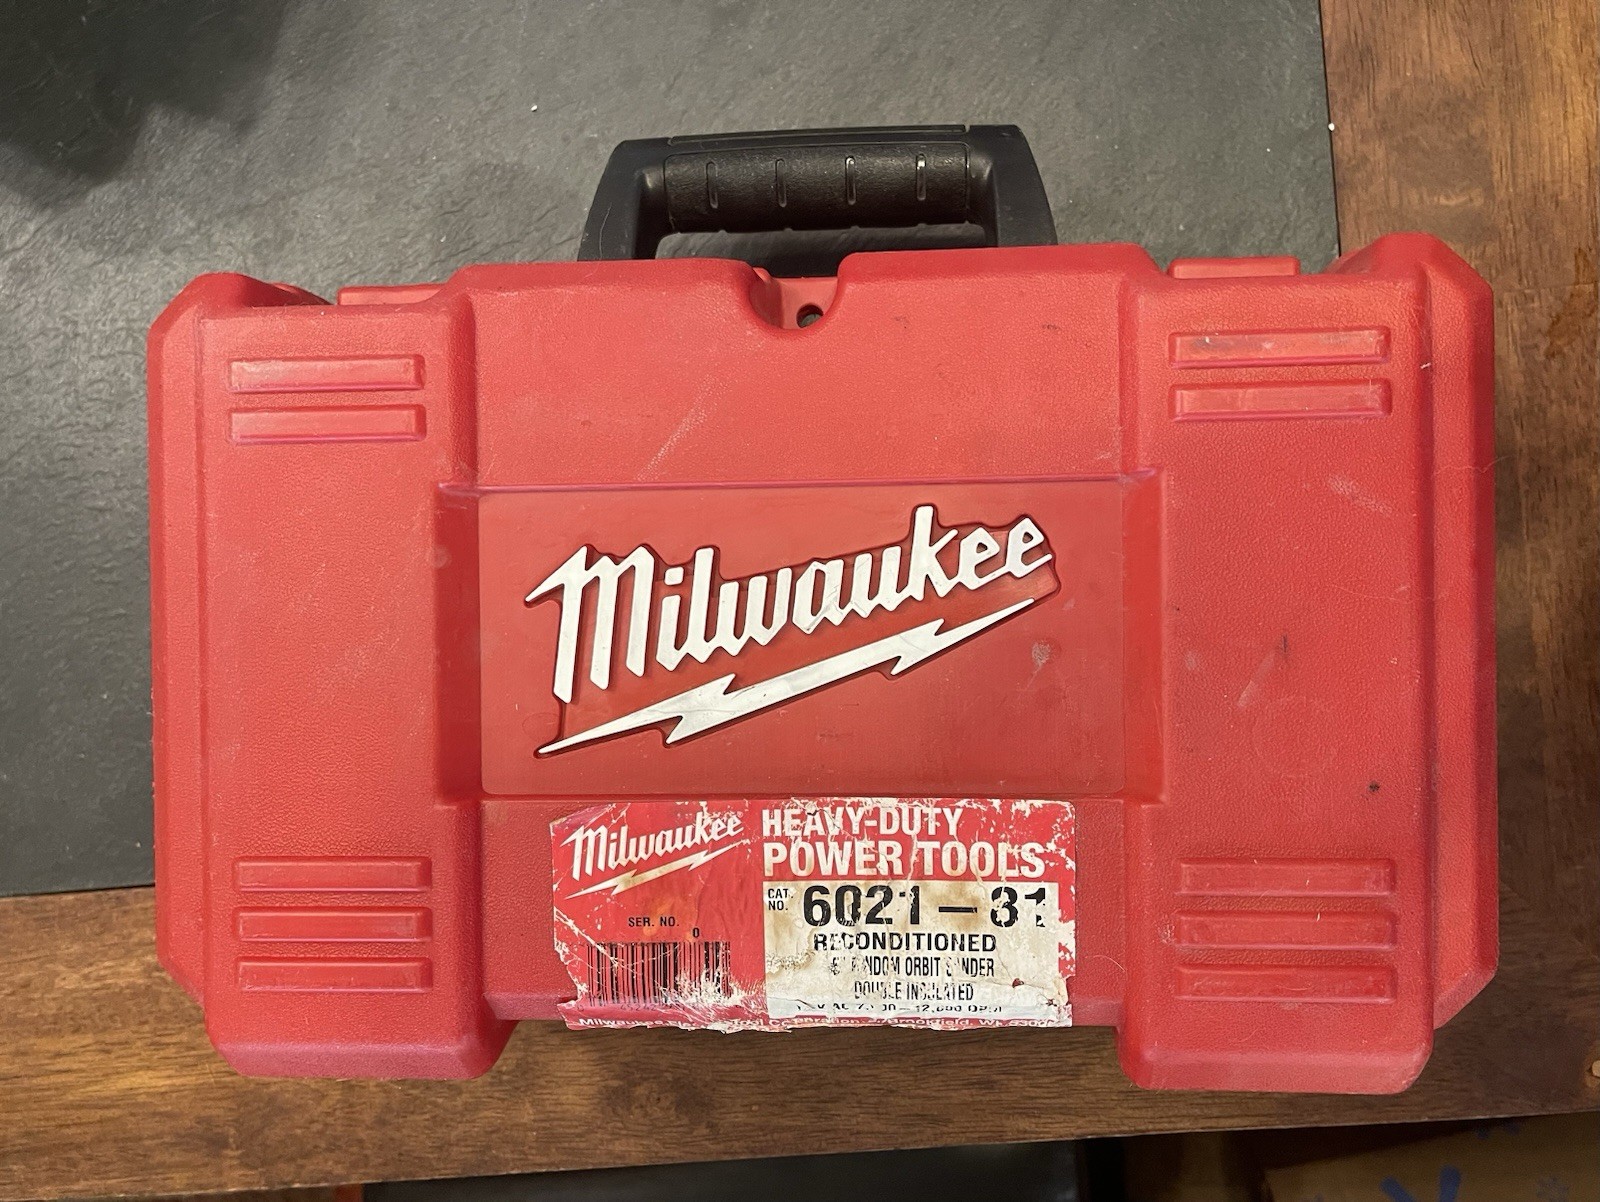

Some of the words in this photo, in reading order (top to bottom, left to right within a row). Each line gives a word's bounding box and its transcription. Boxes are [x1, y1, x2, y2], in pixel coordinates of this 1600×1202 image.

[525, 504, 1053, 704] Milwaukee
[762, 806, 963, 837] HEAVY-DUTY
[560, 811, 744, 881] Milwaukee
[763, 841, 906, 878] POWER
[915, 840, 1046, 878] TOOLS
[768, 900, 789, 911] NO.
[628, 916, 654, 927] SER.
[659, 917, 680, 927] NO.
[813, 931, 997, 952] RECONDITIONED
[905, 956, 941, 977] ORBIT
[946, 957, 995, 978] SNDER
